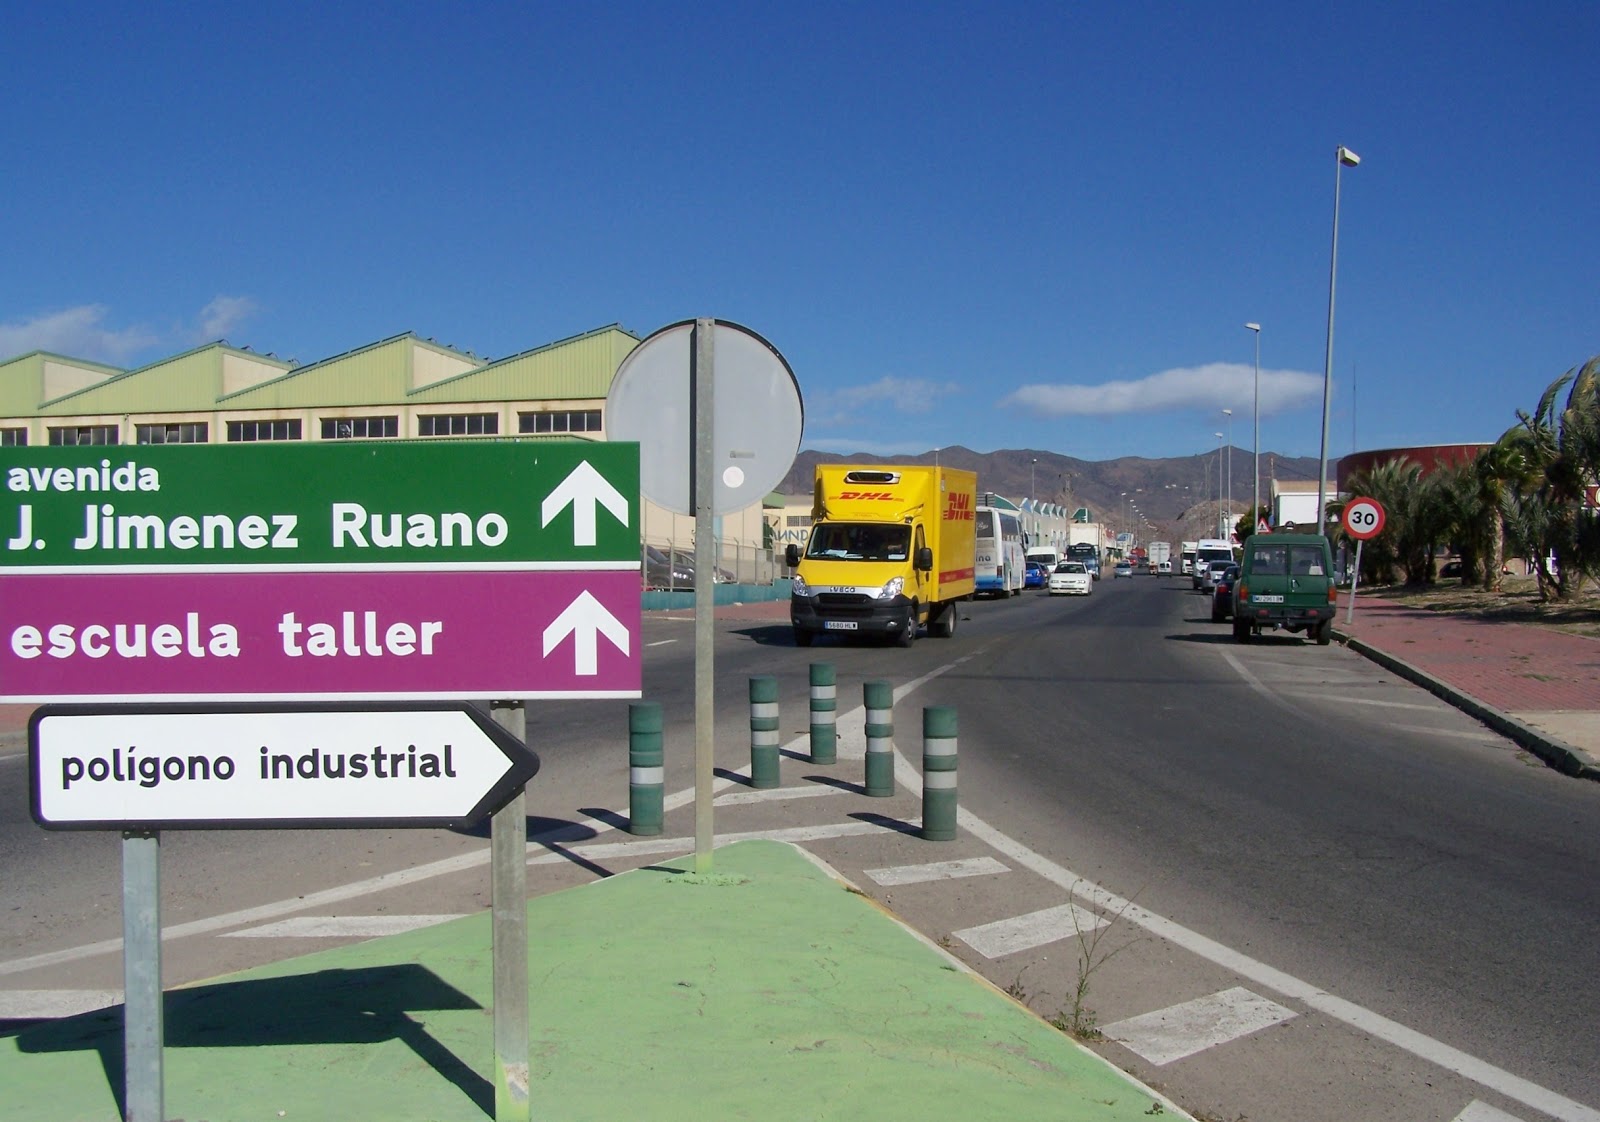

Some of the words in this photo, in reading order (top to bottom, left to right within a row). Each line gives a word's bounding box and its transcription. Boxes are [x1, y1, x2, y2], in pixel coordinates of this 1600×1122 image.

[8, 459, 161, 492] avenida
[839, 491, 894, 501] DHL
[7, 503, 46, 550] J.
[73, 502, 298, 550] Jimenez
[331, 502, 508, 548] Ruano
[1352, 511, 1375, 526] 30
[10, 611, 241, 659] escuela
[277, 610, 443, 657] taller
[61, 745, 234, 789] polígono
[259, 743, 457, 779] industrial
